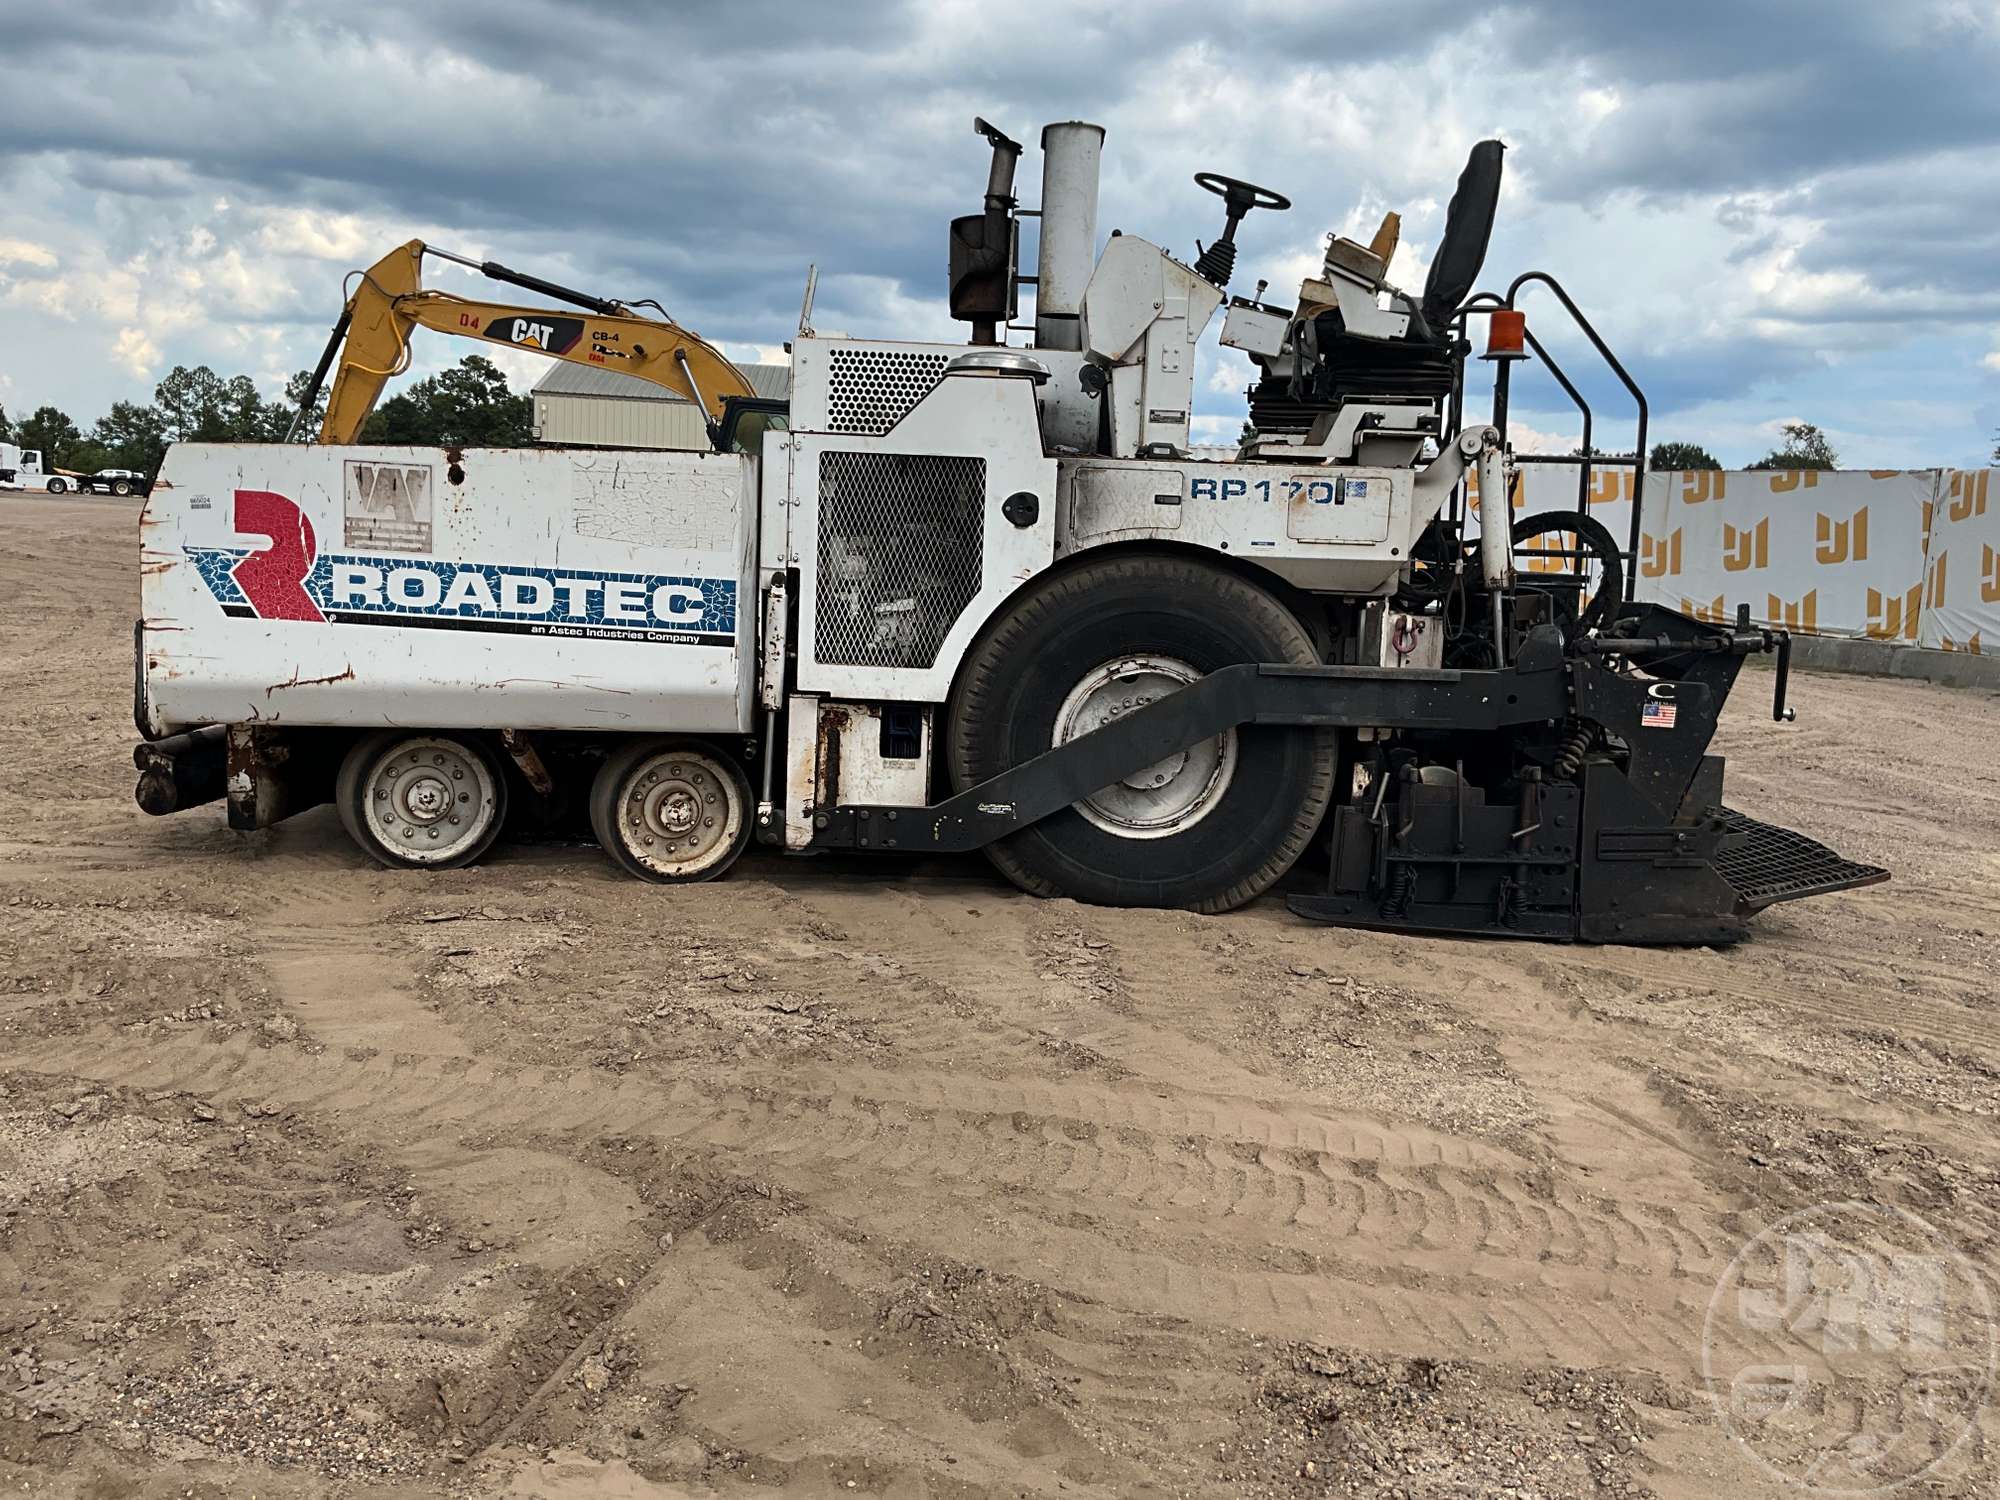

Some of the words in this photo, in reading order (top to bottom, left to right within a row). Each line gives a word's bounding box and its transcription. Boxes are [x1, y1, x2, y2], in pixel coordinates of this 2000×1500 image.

[511, 318, 554, 350] CAT
[592, 331, 619, 342] CB-4
[1191, 479, 1334, 504] RP170
[332, 563, 704, 624] ROADTEC
[549, 626, 583, 636] Astec
[586, 628, 644, 640] Industries
[647, 632, 700, 645] Company
